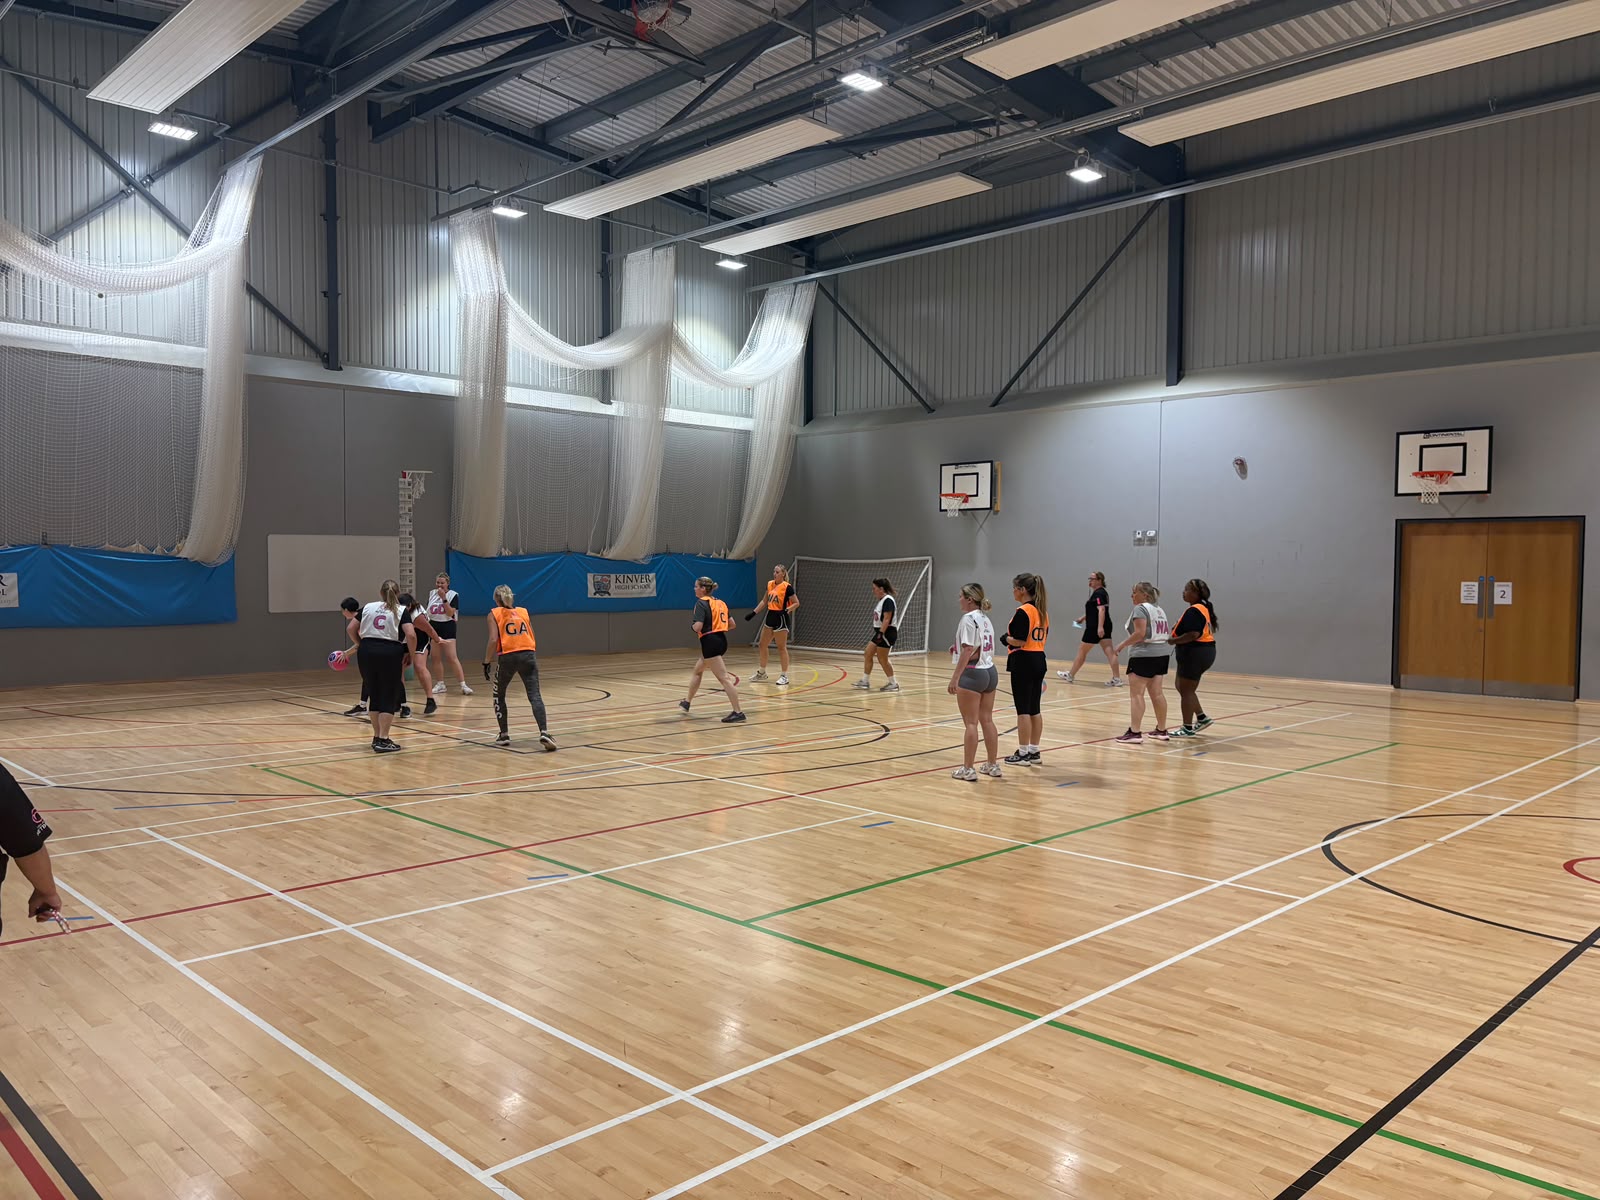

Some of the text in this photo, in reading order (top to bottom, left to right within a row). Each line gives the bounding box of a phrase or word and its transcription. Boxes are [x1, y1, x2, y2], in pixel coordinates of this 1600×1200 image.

[614, 574, 652, 584] KINVER
[1499, 589, 1507, 599] 2
[373, 614, 387, 630] C
[505, 621, 529, 635] GA
